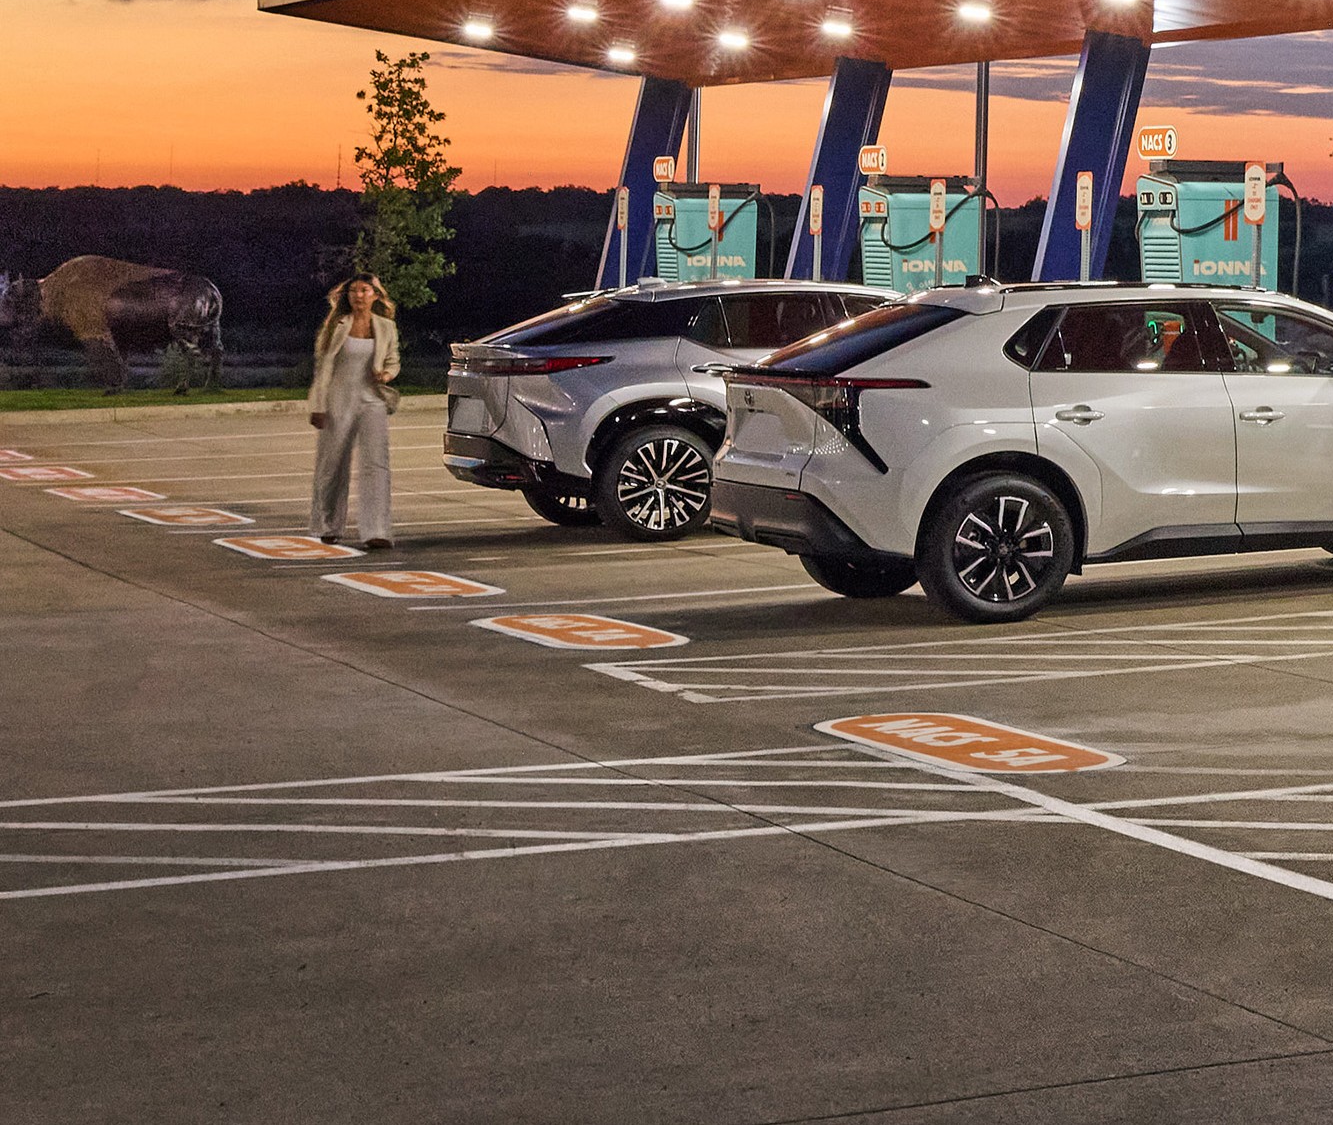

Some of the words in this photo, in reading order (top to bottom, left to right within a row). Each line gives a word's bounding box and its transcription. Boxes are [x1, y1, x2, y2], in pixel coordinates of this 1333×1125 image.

[1141, 134, 1163, 151] NACS
[1167, 134, 1173, 151] 3
[857, 718, 1000, 747] NACS
[969, 747, 1069, 767] 5A
